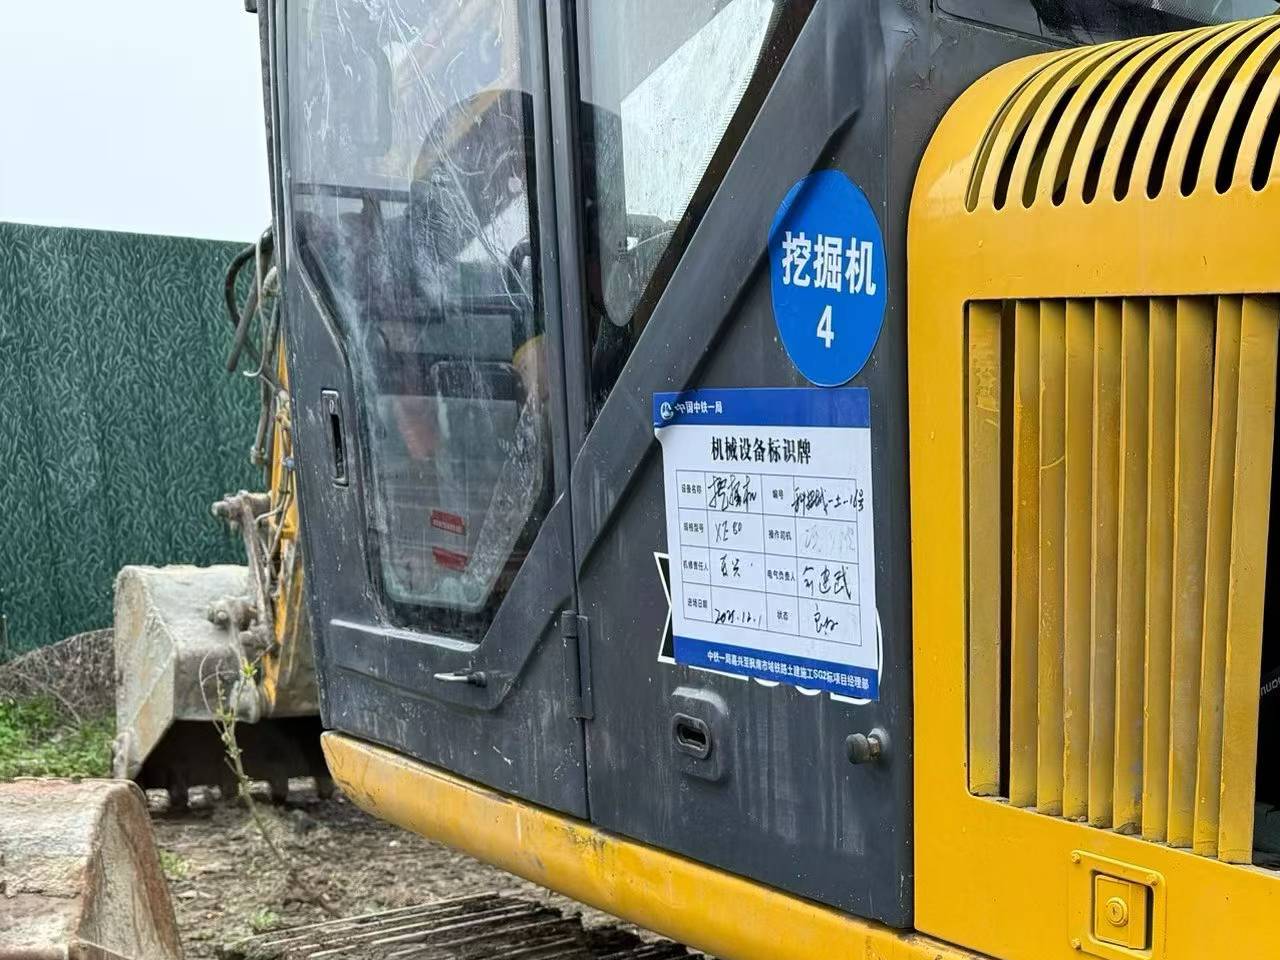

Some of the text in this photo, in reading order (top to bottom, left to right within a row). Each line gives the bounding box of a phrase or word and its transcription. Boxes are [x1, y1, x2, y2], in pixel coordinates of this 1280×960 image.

[781, 231, 877, 296] 挖掘机
[816, 304, 835, 349] 4
[674, 400, 723, 414] 中国中铁一局
[711, 436, 812, 465] 机械设备标识牌
[681, 483, 702, 494] 设备名称
[772, 489, 784, 500] 编号
[683, 522, 704, 533] 规格型号
[768, 529, 792, 541] 操作司机
[767, 569, 796, 582] 电气负责人
[687, 597, 708, 608] 进场日期
[776, 610, 789, 621] 状态
